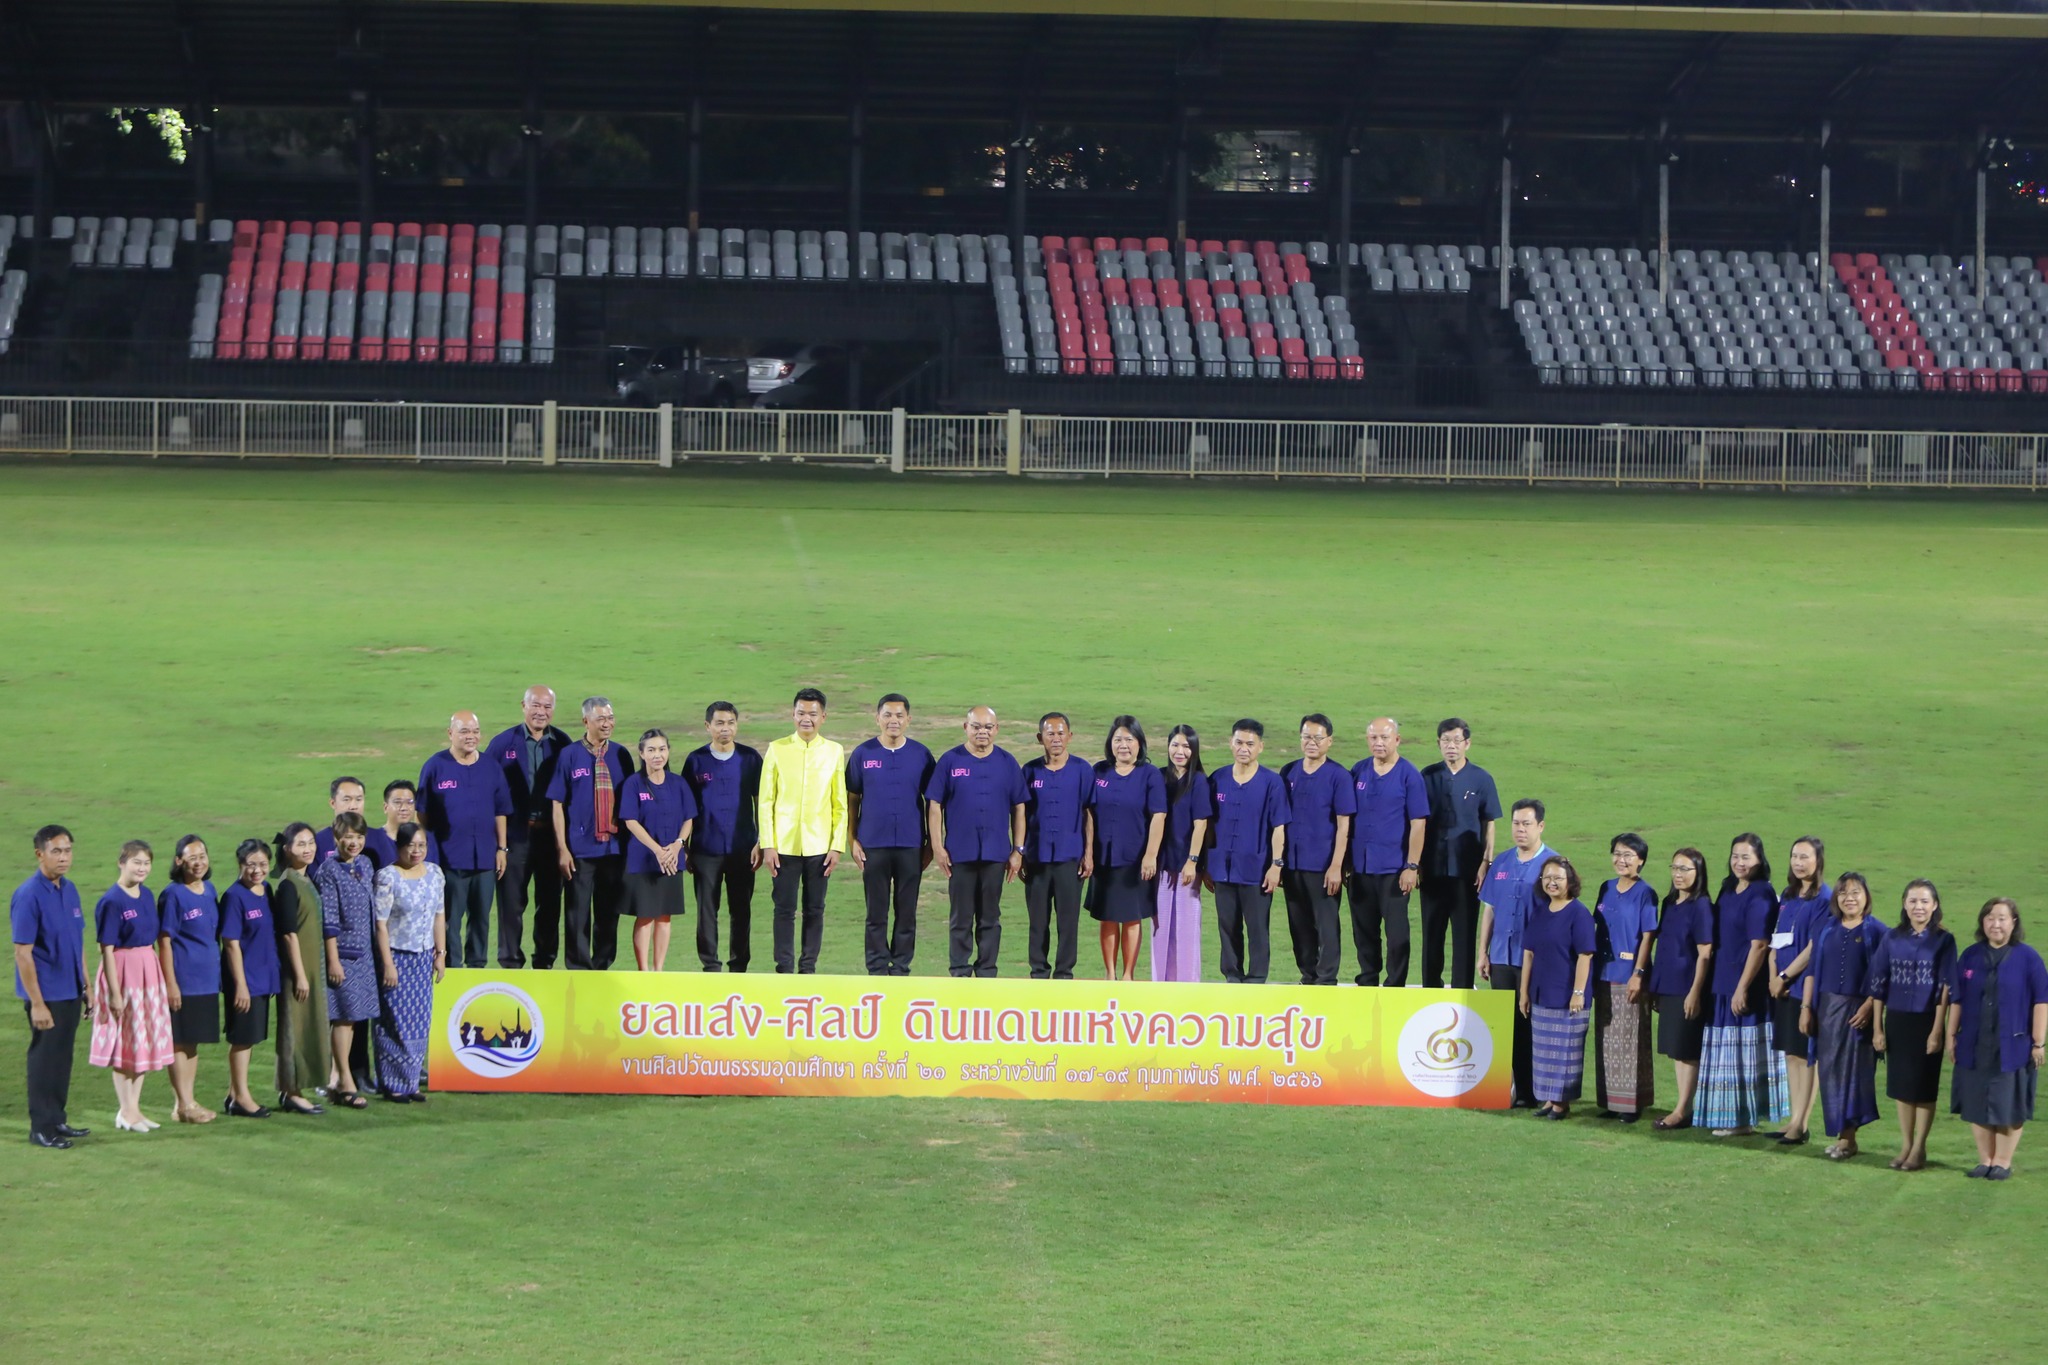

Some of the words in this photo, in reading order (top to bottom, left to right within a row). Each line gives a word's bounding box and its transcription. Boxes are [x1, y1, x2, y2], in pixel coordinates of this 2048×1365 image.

[863, 760, 882, 769] UBRU
[571, 768, 590, 779] UBRU
[951, 768, 970, 777] UBRU
[620, 994, 884, 1040] ยลแสง-ศิลป์
[904, 1000, 1325, 1063] ดินแดนแห่งความสุข
[621, 1052, 855, 1084] งานศิลปวัฒนธรรมอุดมศึกษา
[862, 1050, 910, 1080] ครั้งที่
[916, 1062, 947, 1080] ๒๑
[960, 1053, 1059, 1082] ระหว่างวันที่
[1065, 1066, 1130, 1084] ๑๗-๑๙
[1137, 1062, 1224, 1092] กุมภาพันธ์
[1228, 1066, 1262, 1087] พ.ศ.
[1270, 1071, 1323, 1089] ๒๕๖๖
